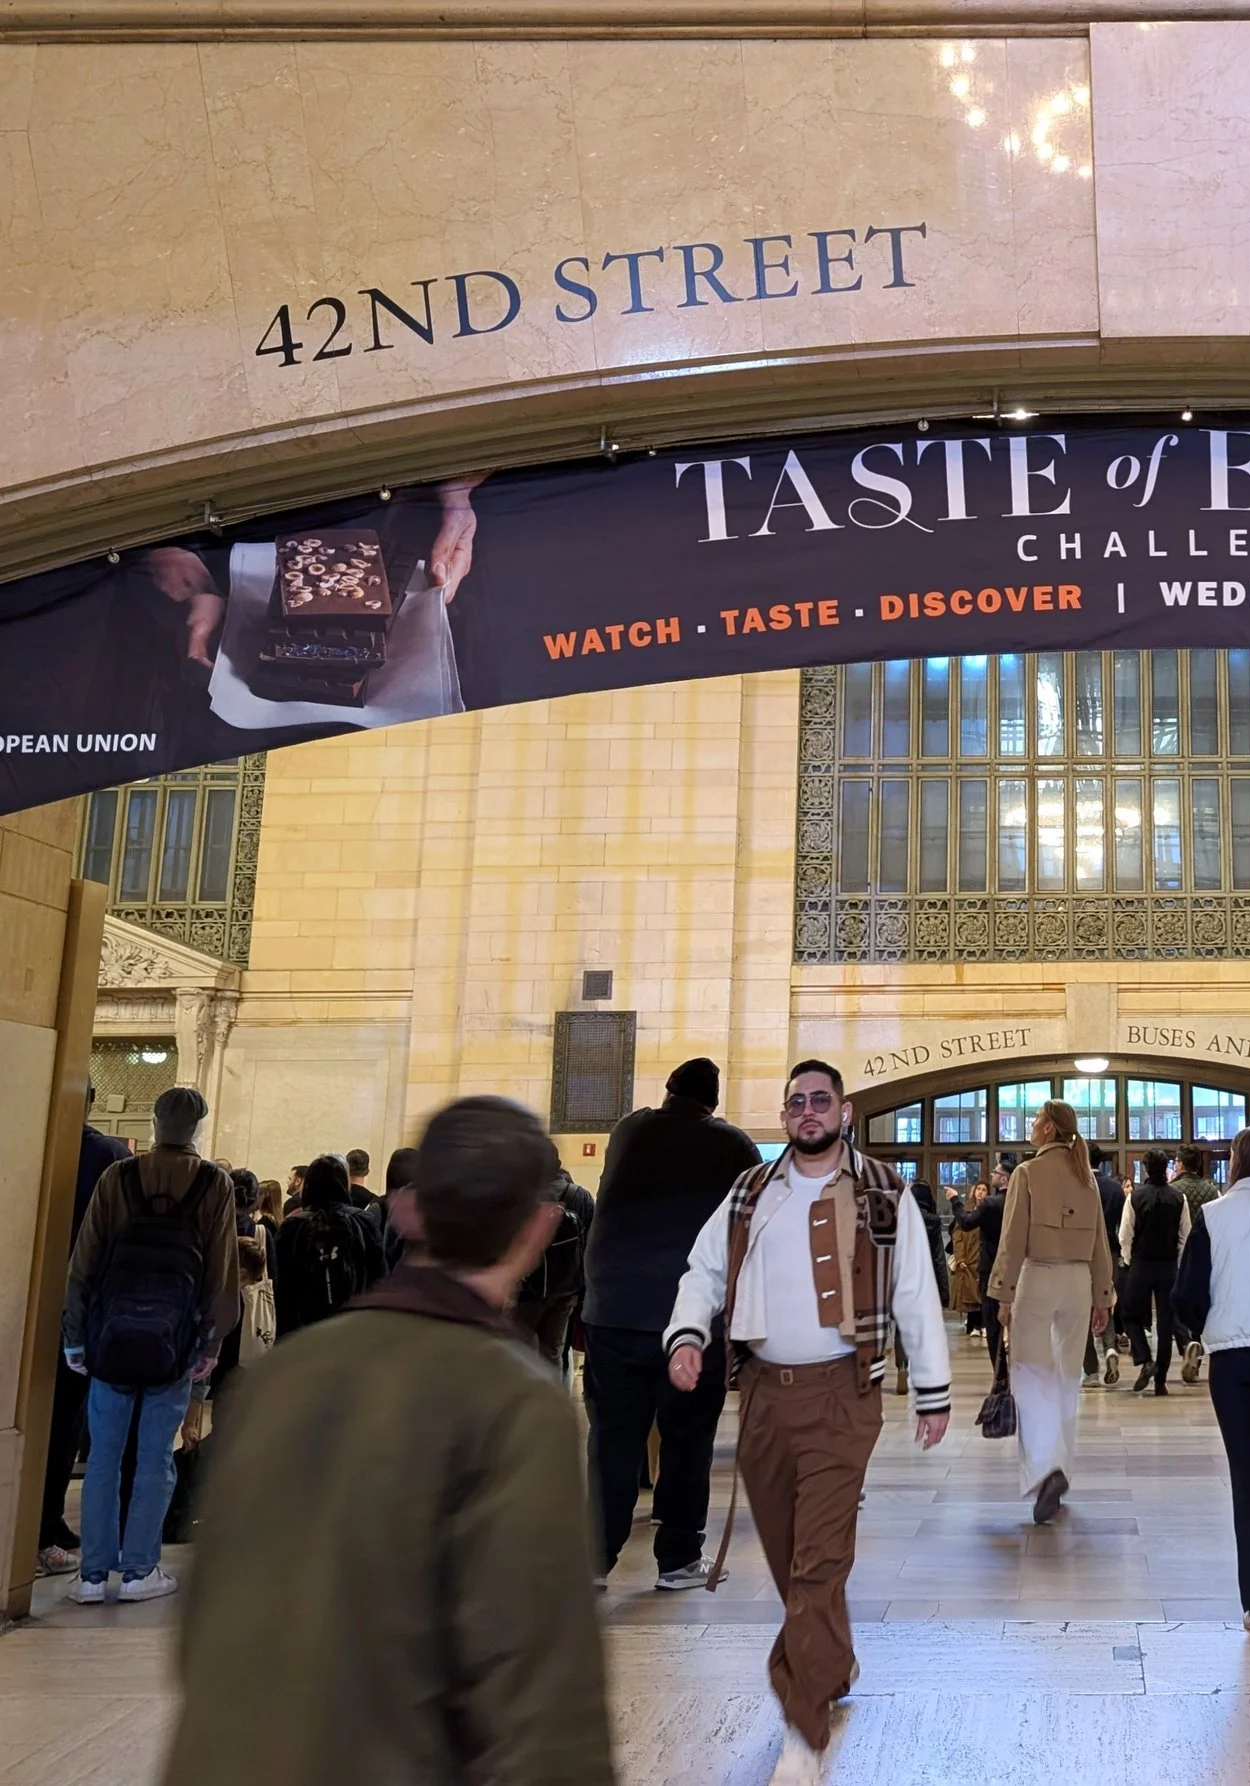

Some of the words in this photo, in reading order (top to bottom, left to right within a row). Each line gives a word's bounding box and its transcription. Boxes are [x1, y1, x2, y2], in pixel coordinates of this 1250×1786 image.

[256, 271, 521, 368] 42ND
[555, 222, 927, 323] STREET
[675, 434, 1072, 543] TASTE
[1107, 434, 1178, 507] of
[543, 617, 681, 660] WATCH
[720, 599, 840, 635] TASTE
[880, 584, 1082, 621] DISCOVER
[0, 734, 69, 753] PEAN
[76, 733, 157, 752] UNION
[863, 1045, 931, 1077] 42ND
[940, 1028, 1031, 1059] STREET
[1127, 1026, 1196, 1049] BUSES
[700, 1562, 710, 1573] N
